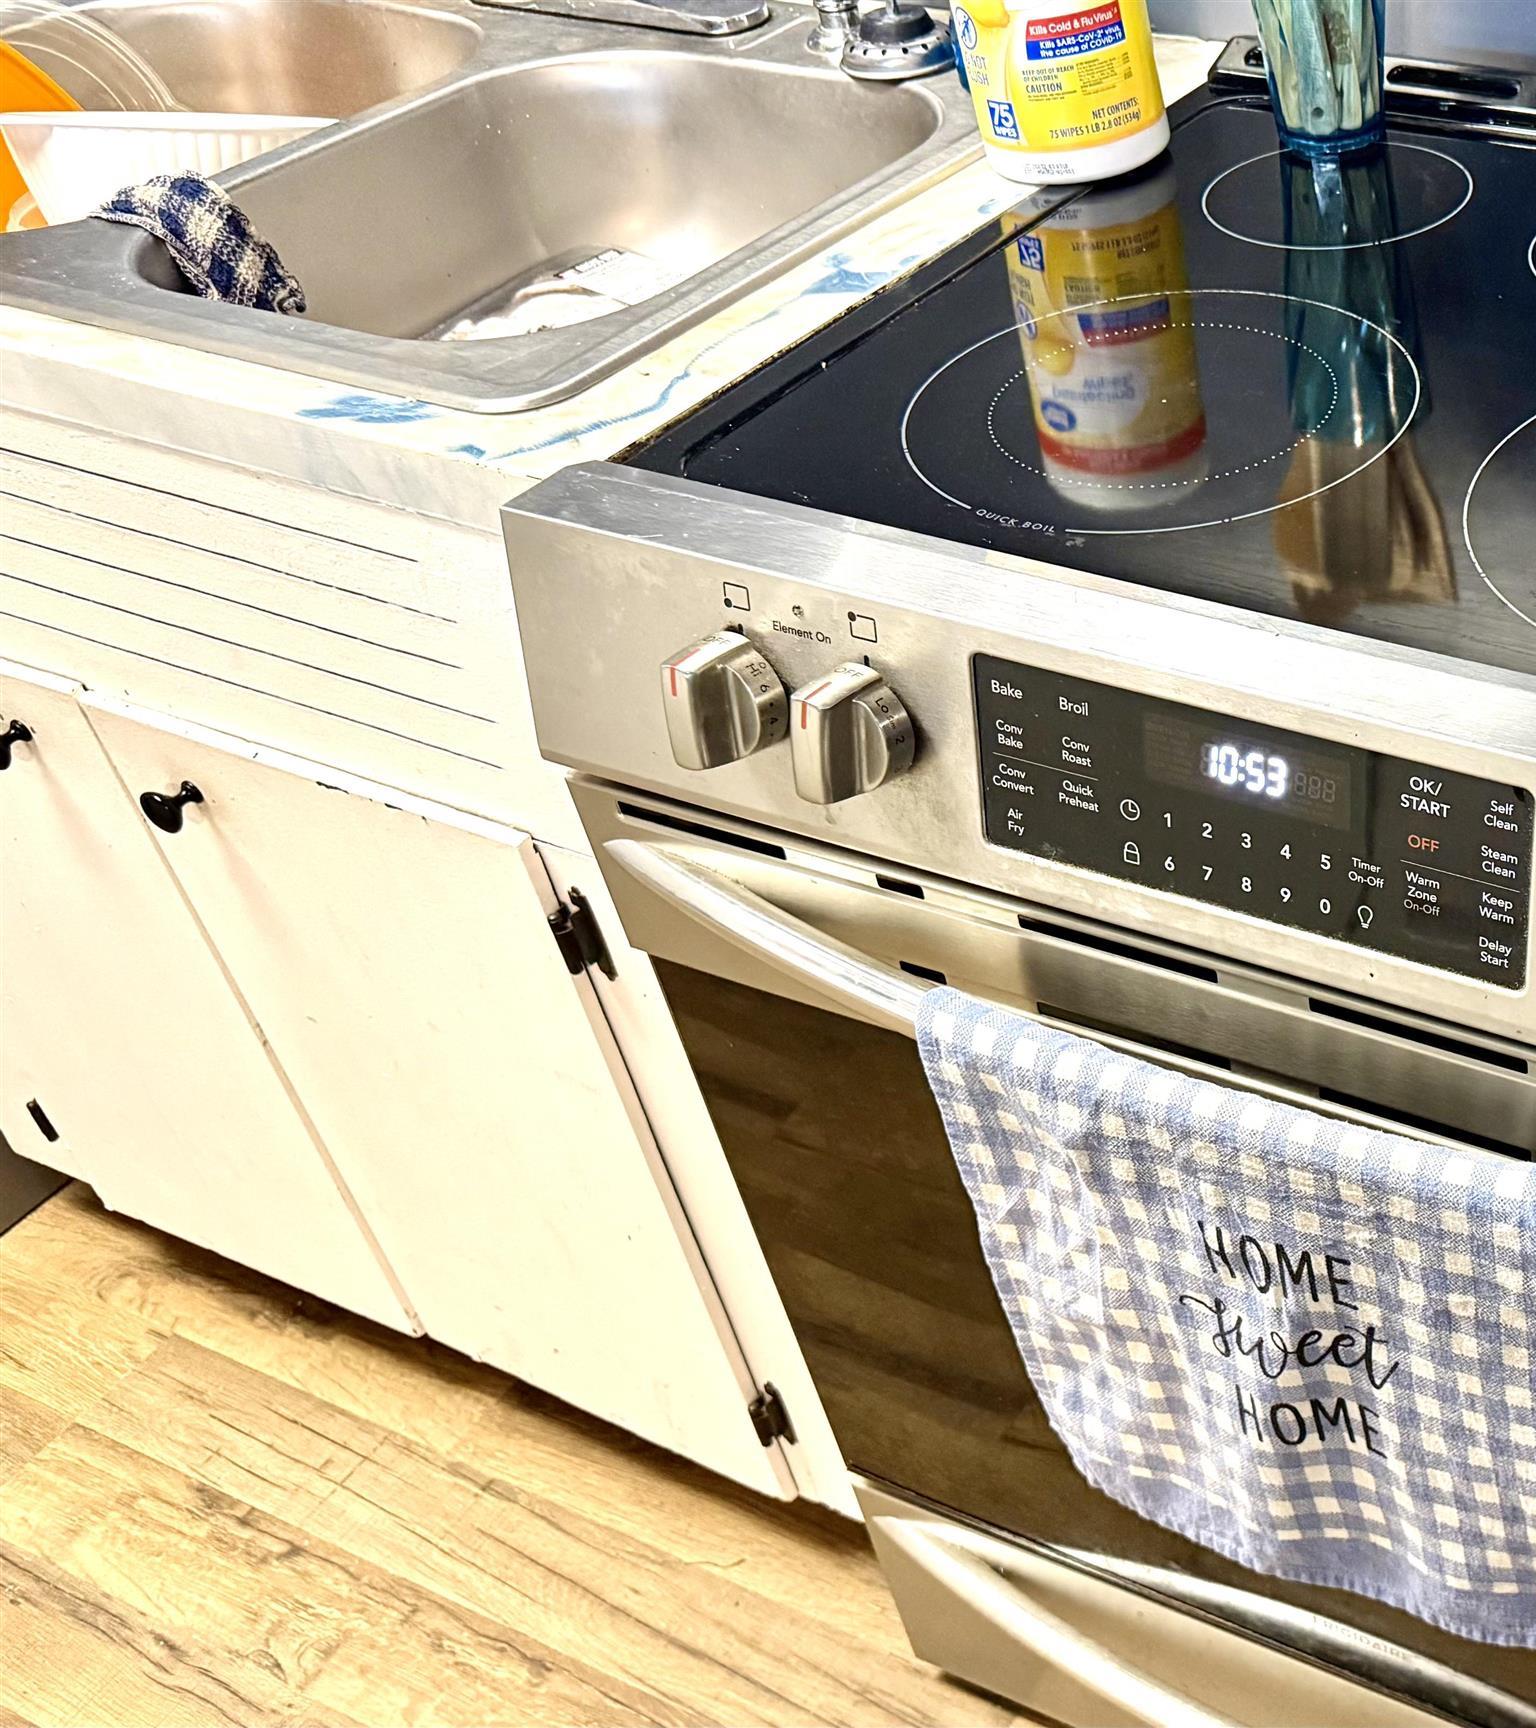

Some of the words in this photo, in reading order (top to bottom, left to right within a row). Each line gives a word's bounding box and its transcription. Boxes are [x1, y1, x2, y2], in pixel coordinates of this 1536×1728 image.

[1029, 25, 1048, 35] Kills
[1048, 21, 1072, 33] Cold
[1072, 18, 1080, 29] &
[1081, 16, 1093, 27] Flu
[1040, 49, 1053, 58] the
[1055, 46, 1080, 56] cause
[1081, 42, 1089, 51] of
[1089, 31, 1122, 48] COVID-19
[1040, 41, 1055, 50] Kills
[1056, 64, 1075, 73] REACH
[1025, 82, 1063, 94] CAUTION
[989, 101, 1015, 129] 75
[1092, 107, 1106, 120] NET
[994, 124, 1018, 139] WIPES
[1049, 129, 1059, 139] 75
[1060, 125, 1085, 138] WIPES
[1090, 122, 1100, 133] LB
[1113, 116, 1122, 127] OZ
[975, 508, 1019, 527] QUICK
[1021, 521, 1056, 533] BOIL
[771, 620, 811, 641] Element
[812, 629, 832, 645] On
[991, 679, 1024, 700] Bake
[875, 697, 889, 714] Lo
[1058, 696, 1089, 717] Broil
[995, 719, 1024, 736] Conv
[997, 733, 1024, 750] Bake
[1062, 736, 1090, 753] Conv
[1061, 750, 1092, 768] Roast
[998, 763, 1026, 780] Conv
[1208, 745, 1289, 799] 10:53
[992, 775, 1035, 795] Convert
[1062, 780, 1094, 798] Quick
[1409, 775, 1443, 796] OK/
[1058, 792, 1100, 813] Preheat
[1400, 794, 1451, 818] START
[1490, 800, 1515, 817] Self
[1007, 807, 1024, 821] Air
[1163, 812, 1173, 828] 1
[1008, 821, 1025, 837] Fry
[1202, 823, 1213, 839] 2
[1483, 814, 1519, 833] Clean
[1241, 833, 1252, 849] 3
[1407, 834, 1440, 853] OFF
[1280, 844, 1292, 860] 4
[1481, 845, 1519, 865] Steam
[1164, 856, 1175, 872] 6
[1320, 854, 1331, 871] 5
[1351, 857, 1382, 873] Timer
[1481, 860, 1516, 879] Clean
[1202, 866, 1213, 881] 7
[1348, 871, 1385, 889] On-Off
[1405, 870, 1440, 890] Warm
[1241, 876, 1252, 893] 8
[1280, 887, 1292, 903] 9
[1407, 885, 1438, 903] Zone
[1482, 891, 1513, 911] Keep
[1320, 898, 1331, 914] 0
[1403, 899, 1440, 917] On-Off
[1479, 905, 1515, 925] Warm
[1478, 936, 1512, 956] Delay
[1480, 951, 1509, 968] Start
[1197, 1220, 1359, 1311] HOME
[1179, 1295, 1400, 1390] Sweet
[1235, 1384, 1388, 1459] HOME
